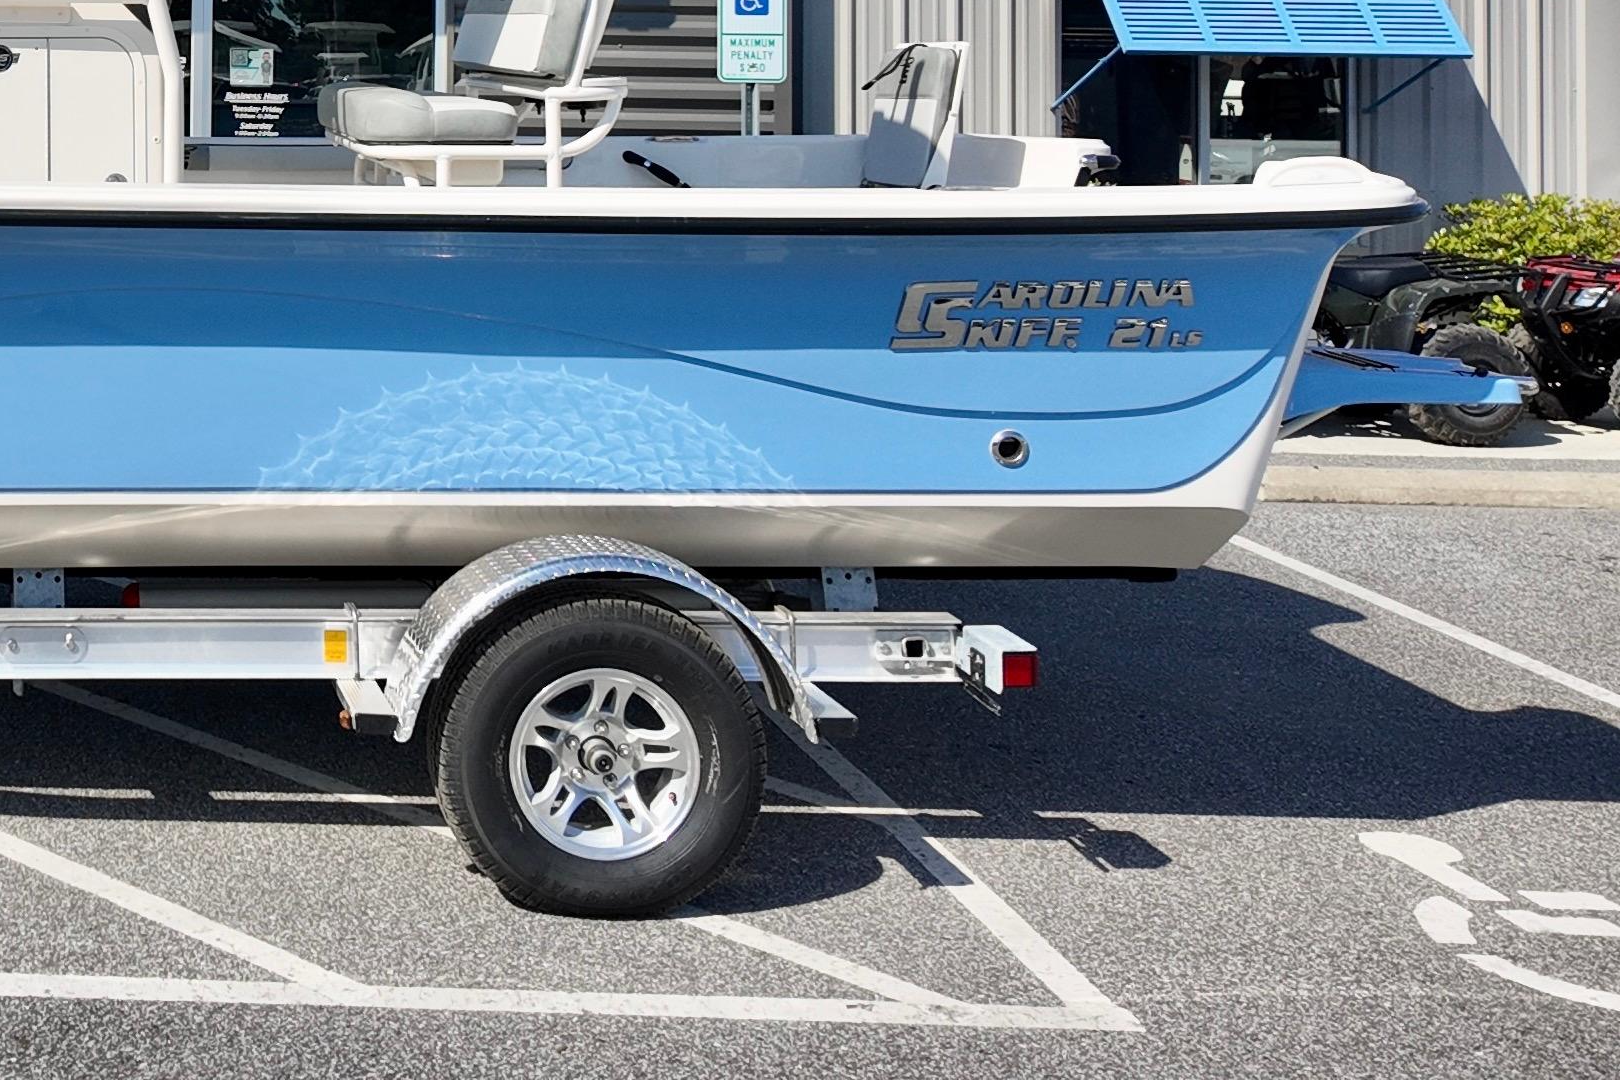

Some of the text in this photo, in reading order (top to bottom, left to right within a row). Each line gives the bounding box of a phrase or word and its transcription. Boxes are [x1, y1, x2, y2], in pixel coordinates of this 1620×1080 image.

[729, 38, 776, 48] MAXIMUM
[730, 50, 773, 61] PENALTY
[895, 279, 1196, 333] CAROLINA
[890, 297, 1084, 352] SKIFF
